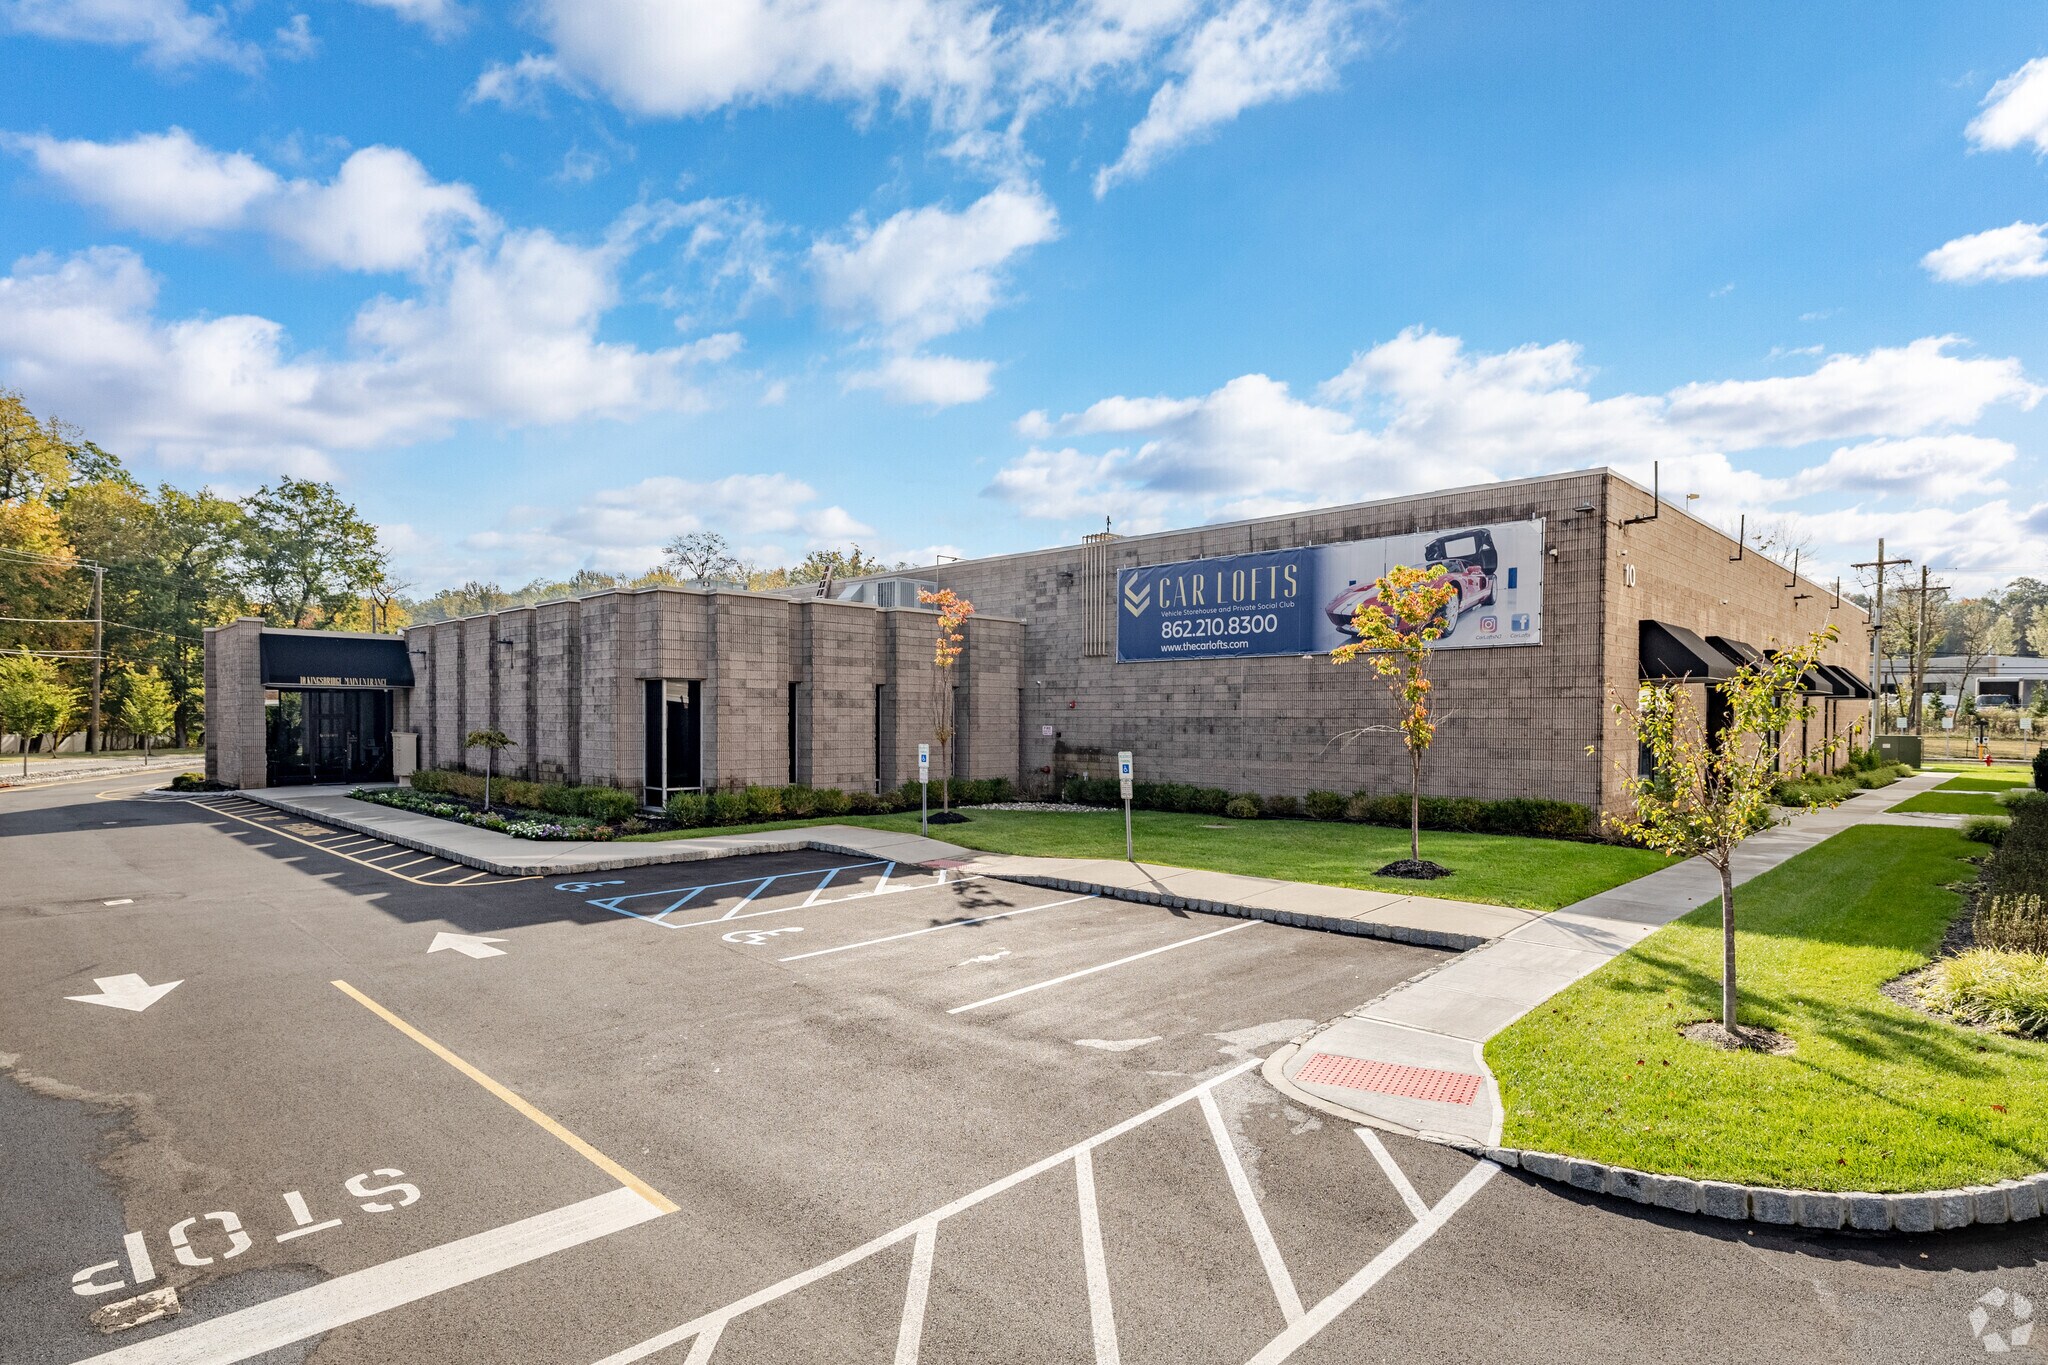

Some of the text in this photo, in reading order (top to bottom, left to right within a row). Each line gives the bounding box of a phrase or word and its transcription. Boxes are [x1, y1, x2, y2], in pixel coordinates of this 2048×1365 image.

[1160, 564, 1297, 608] CAR LOFTS
[1626, 563, 1636, 587] 10
[1183, 608, 1217, 616] Storehouse
[1218, 605, 1231, 613] and
[1257, 602, 1277, 610] Social
[1161, 614, 1278, 638] 862.210.8300
[1161, 640, 1249, 652] www.thecarlofts.com
[72, 1168, 421, 1296] STOP
